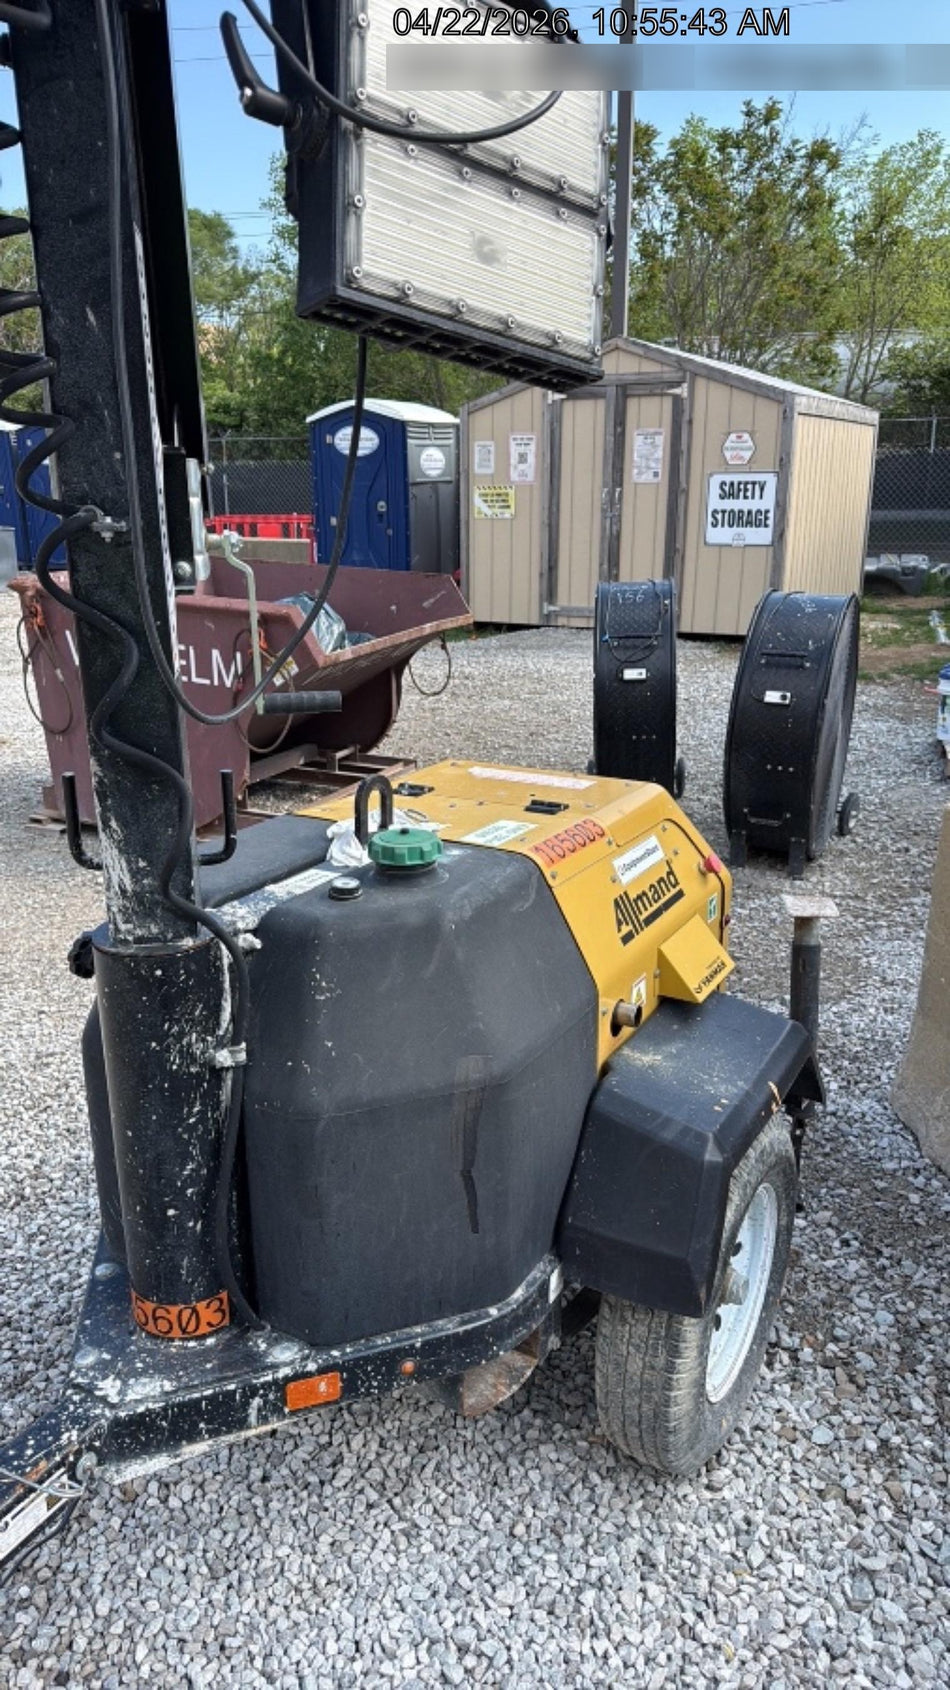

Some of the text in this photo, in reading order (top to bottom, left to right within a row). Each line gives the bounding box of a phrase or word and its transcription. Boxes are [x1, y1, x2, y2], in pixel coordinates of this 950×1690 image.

[718, 480, 766, 500] SAFETY
[711, 508, 770, 528] STORAGE
[613, 859, 681, 936] Allmand
